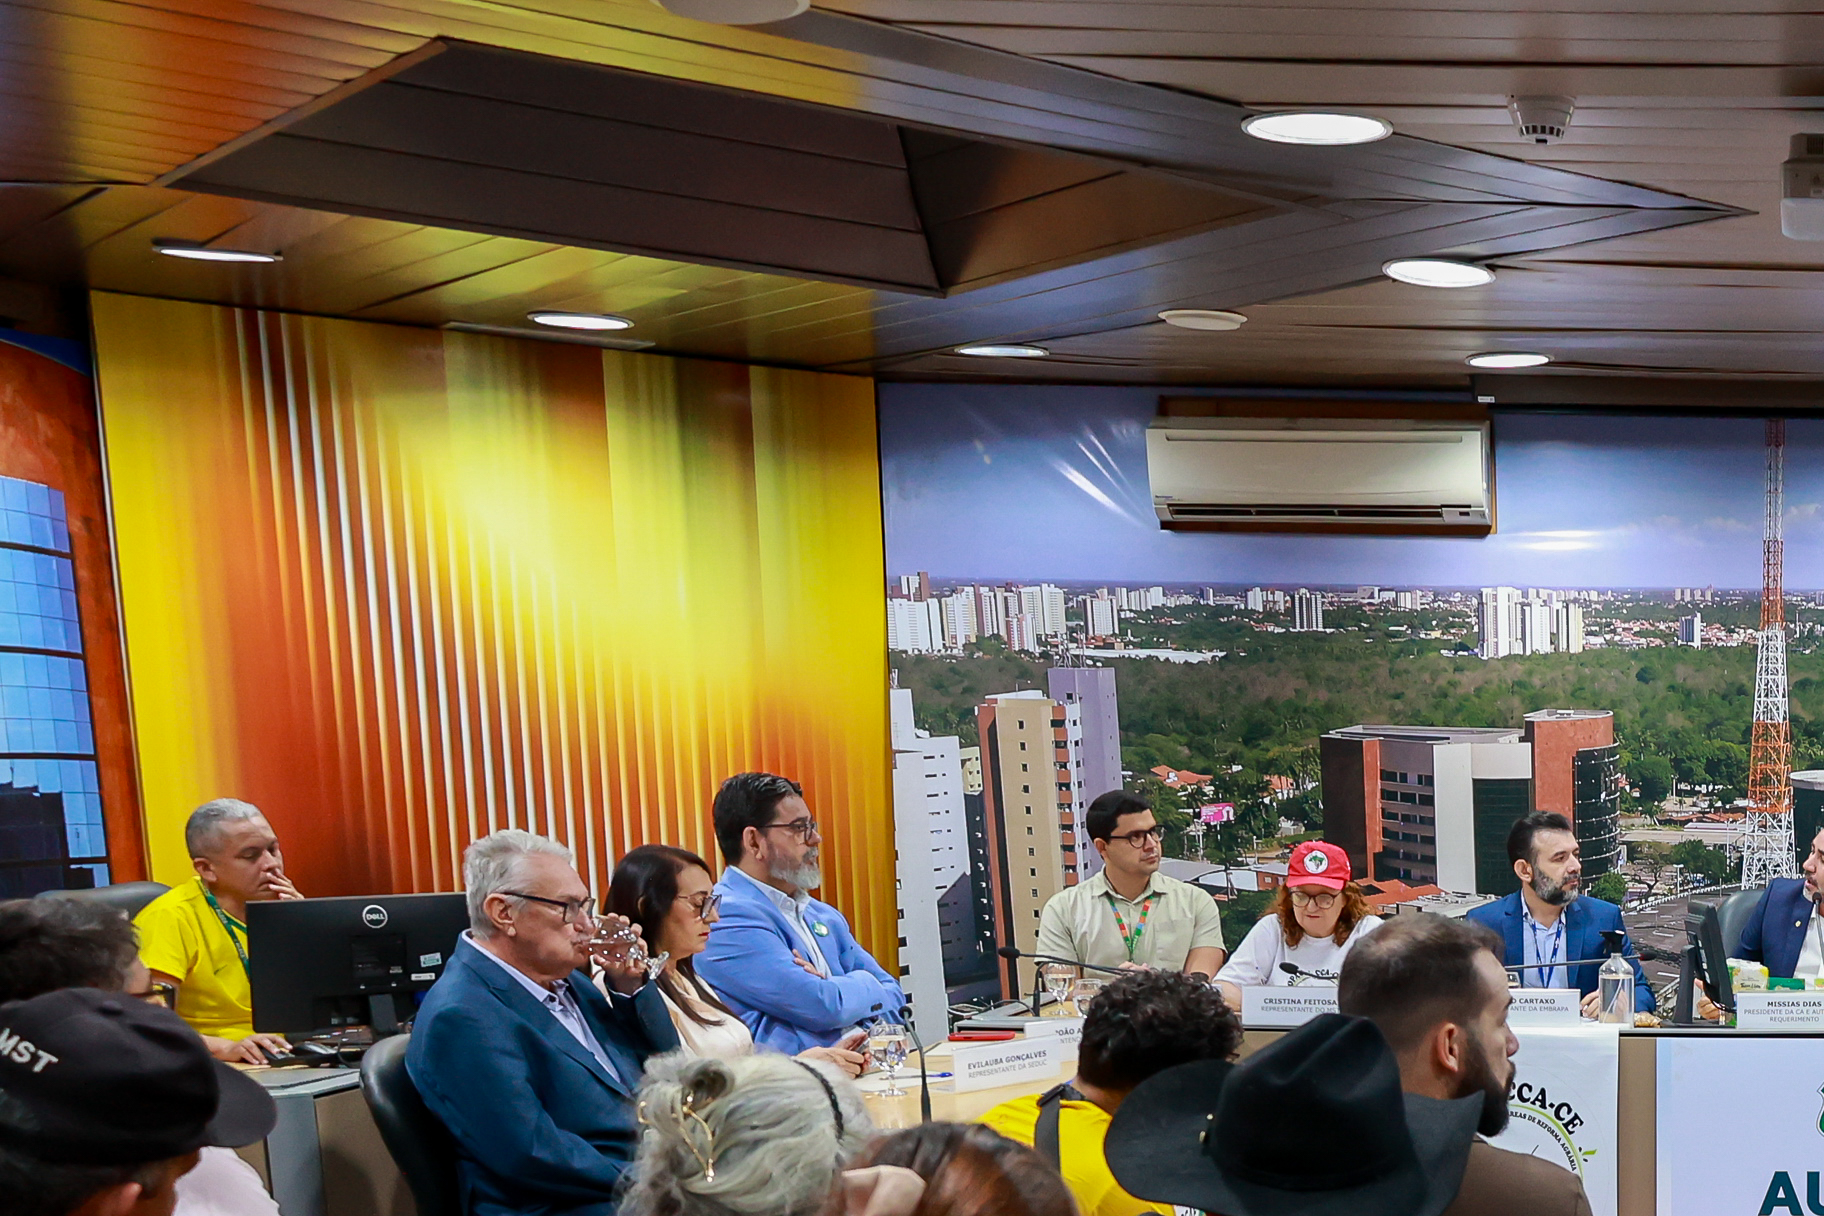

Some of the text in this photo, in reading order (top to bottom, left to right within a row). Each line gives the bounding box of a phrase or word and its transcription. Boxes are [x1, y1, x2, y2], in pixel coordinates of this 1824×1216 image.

[968, 1050, 1047, 1070] EVILAUBA GONÇALVES
[968, 1065, 1016, 1078] REPRESENTANTE
[1028, 1060, 1047, 1069] SEDUC
[1528, 1115, 1536, 1123] DE
[1536, 1117, 1562, 1143] REFORMA
[1560, 1142, 1577, 1171] AGRÁRIA
